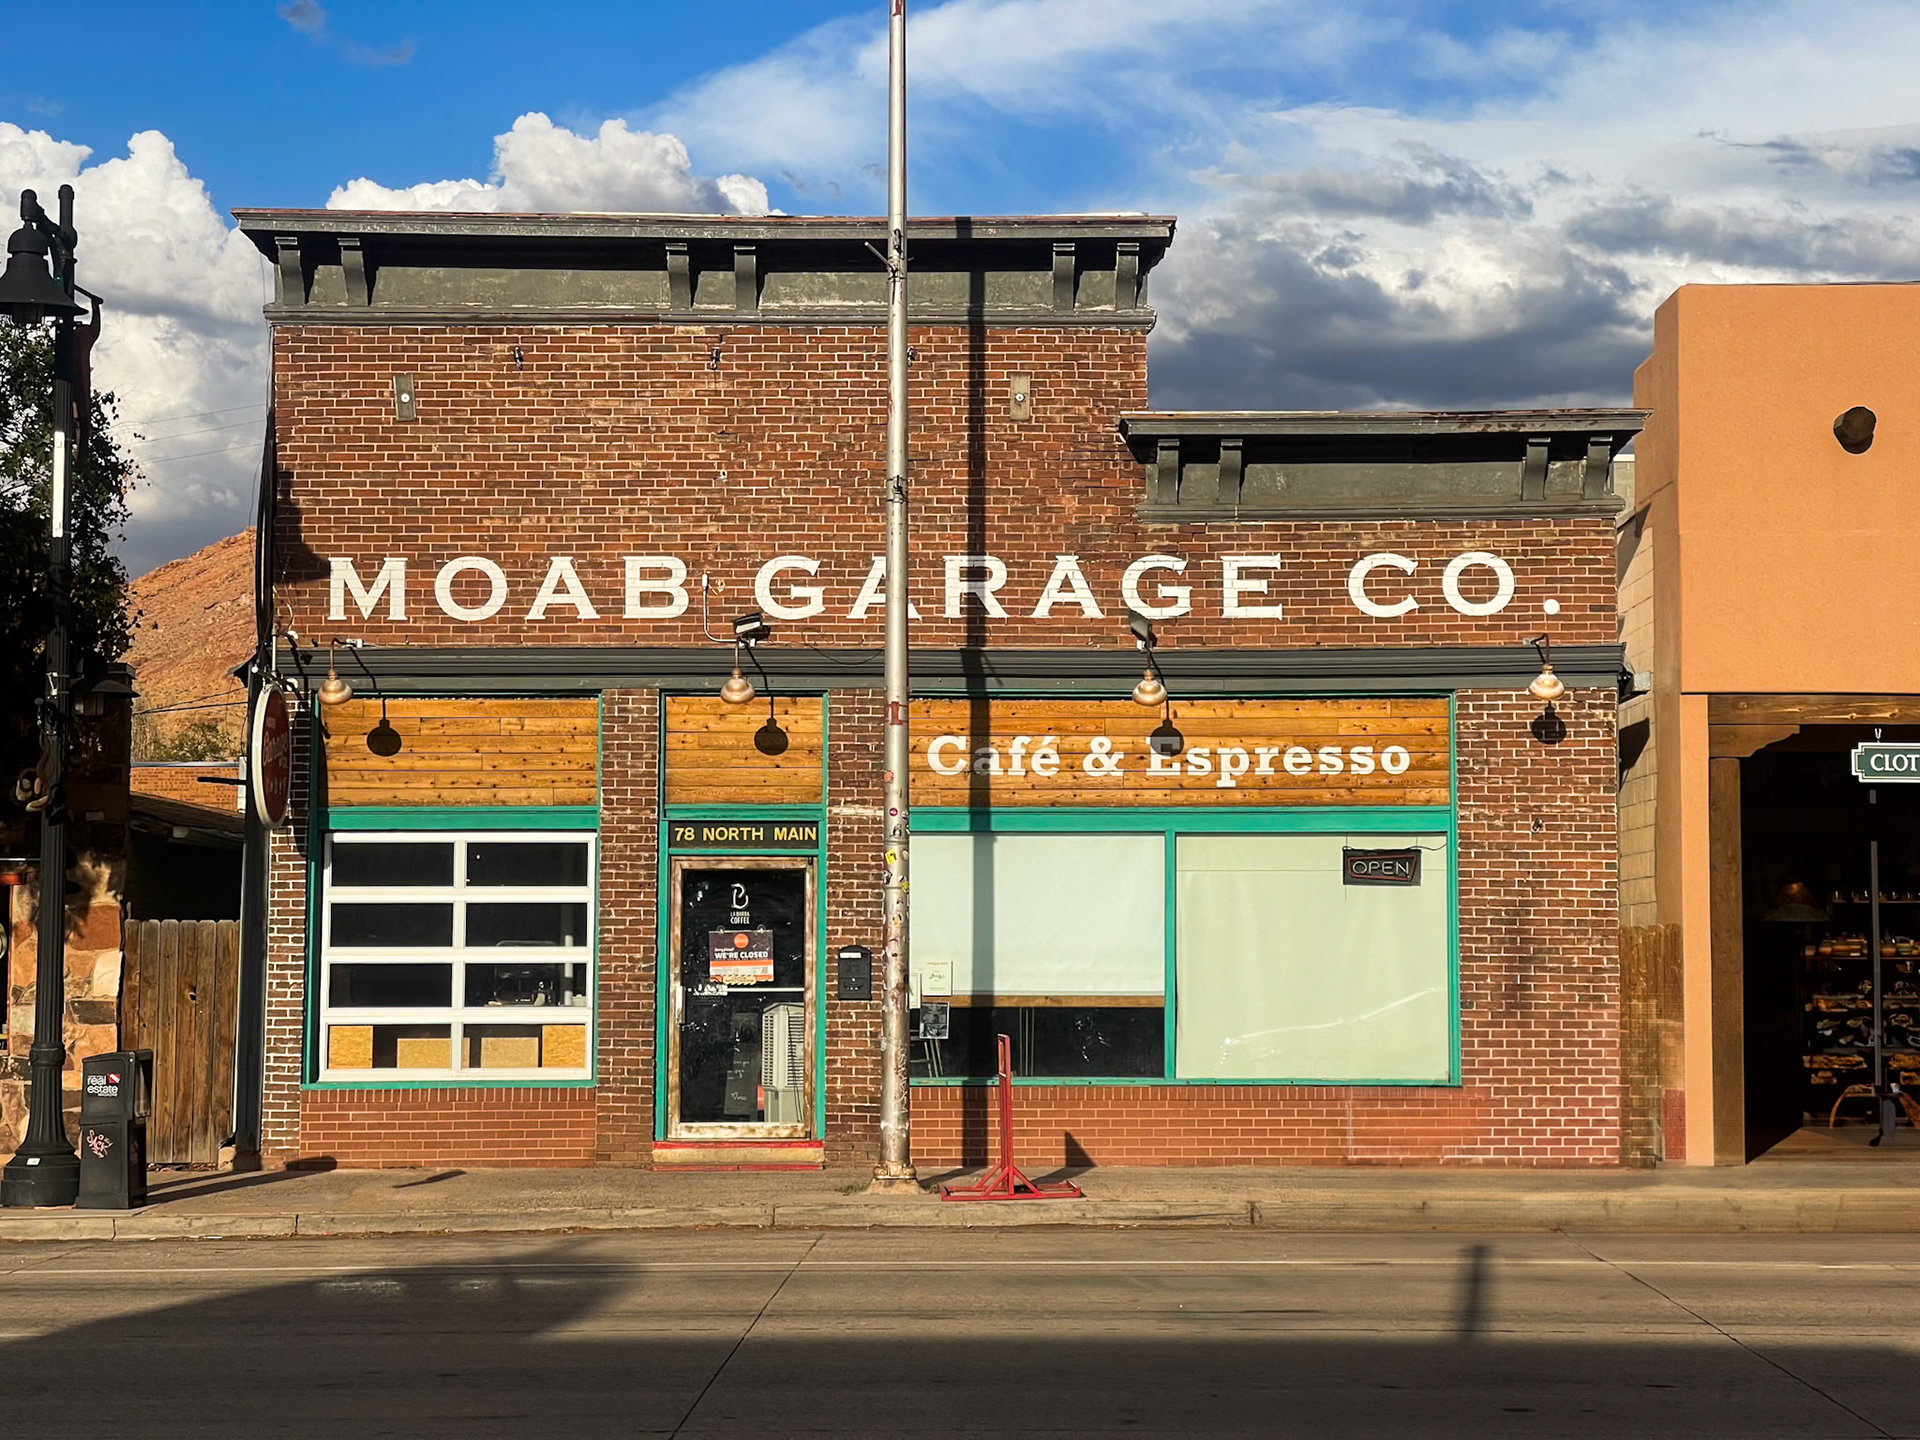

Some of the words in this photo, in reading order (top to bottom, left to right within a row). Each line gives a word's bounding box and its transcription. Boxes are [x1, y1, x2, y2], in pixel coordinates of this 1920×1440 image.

[327, 556, 689, 622] MOAB
[754, 555, 1284, 621] GARAGE
[1348, 552, 1560, 618] CO.
[927, 734, 1060, 777] Café
[1082, 736, 1124, 777] &
[1145, 736, 1412, 788] Espresso
[1870, 753, 1920, 772] CLOT
[674, 826, 695, 841] 78
[702, 826, 764, 841] NORTH
[774, 826, 817, 841] MAIN
[1352, 860, 1409, 875] OPEN
[730, 917, 750, 925] COFFEE
[740, 951, 769, 959] CLOSED
[87, 1075, 107, 1085] real
[87, 1085, 119, 1094] estate
